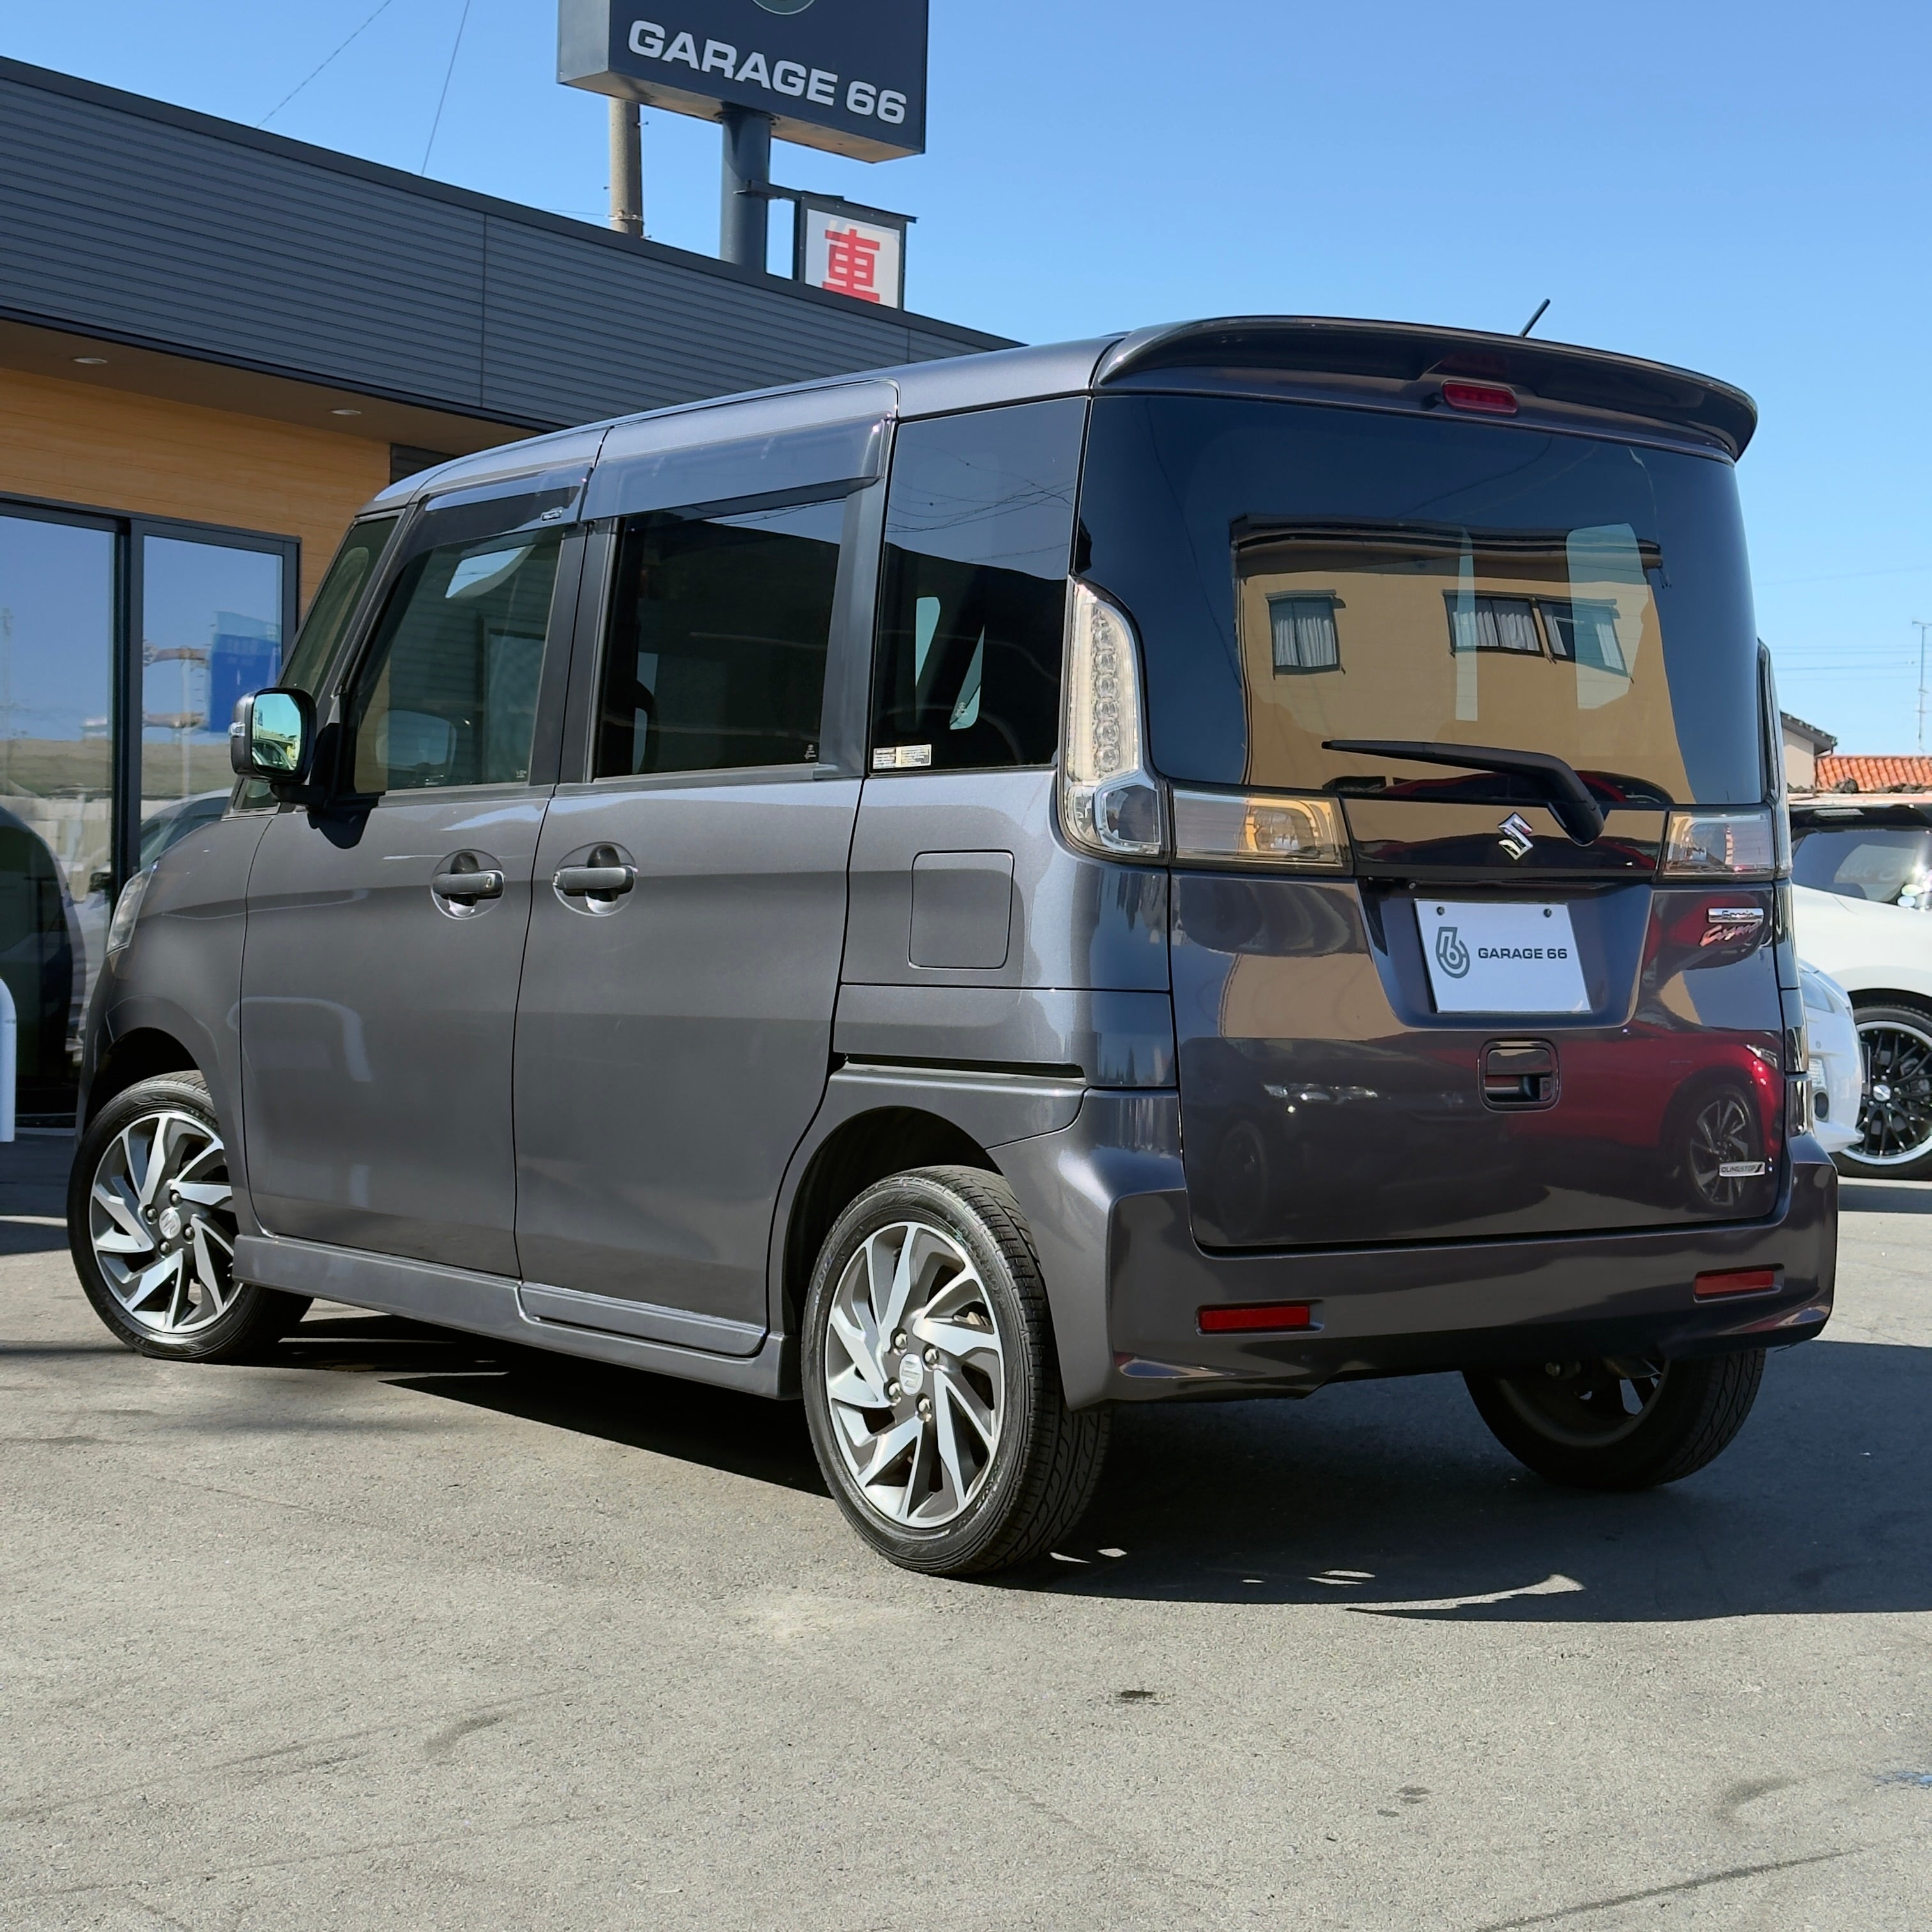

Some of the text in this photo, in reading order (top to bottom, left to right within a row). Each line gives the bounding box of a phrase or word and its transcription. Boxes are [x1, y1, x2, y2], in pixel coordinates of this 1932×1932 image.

[628, 20, 907, 125] GARAGE 66
[822, 227, 880, 302] 車
[1478, 947, 1568, 959] GARAGE 66
